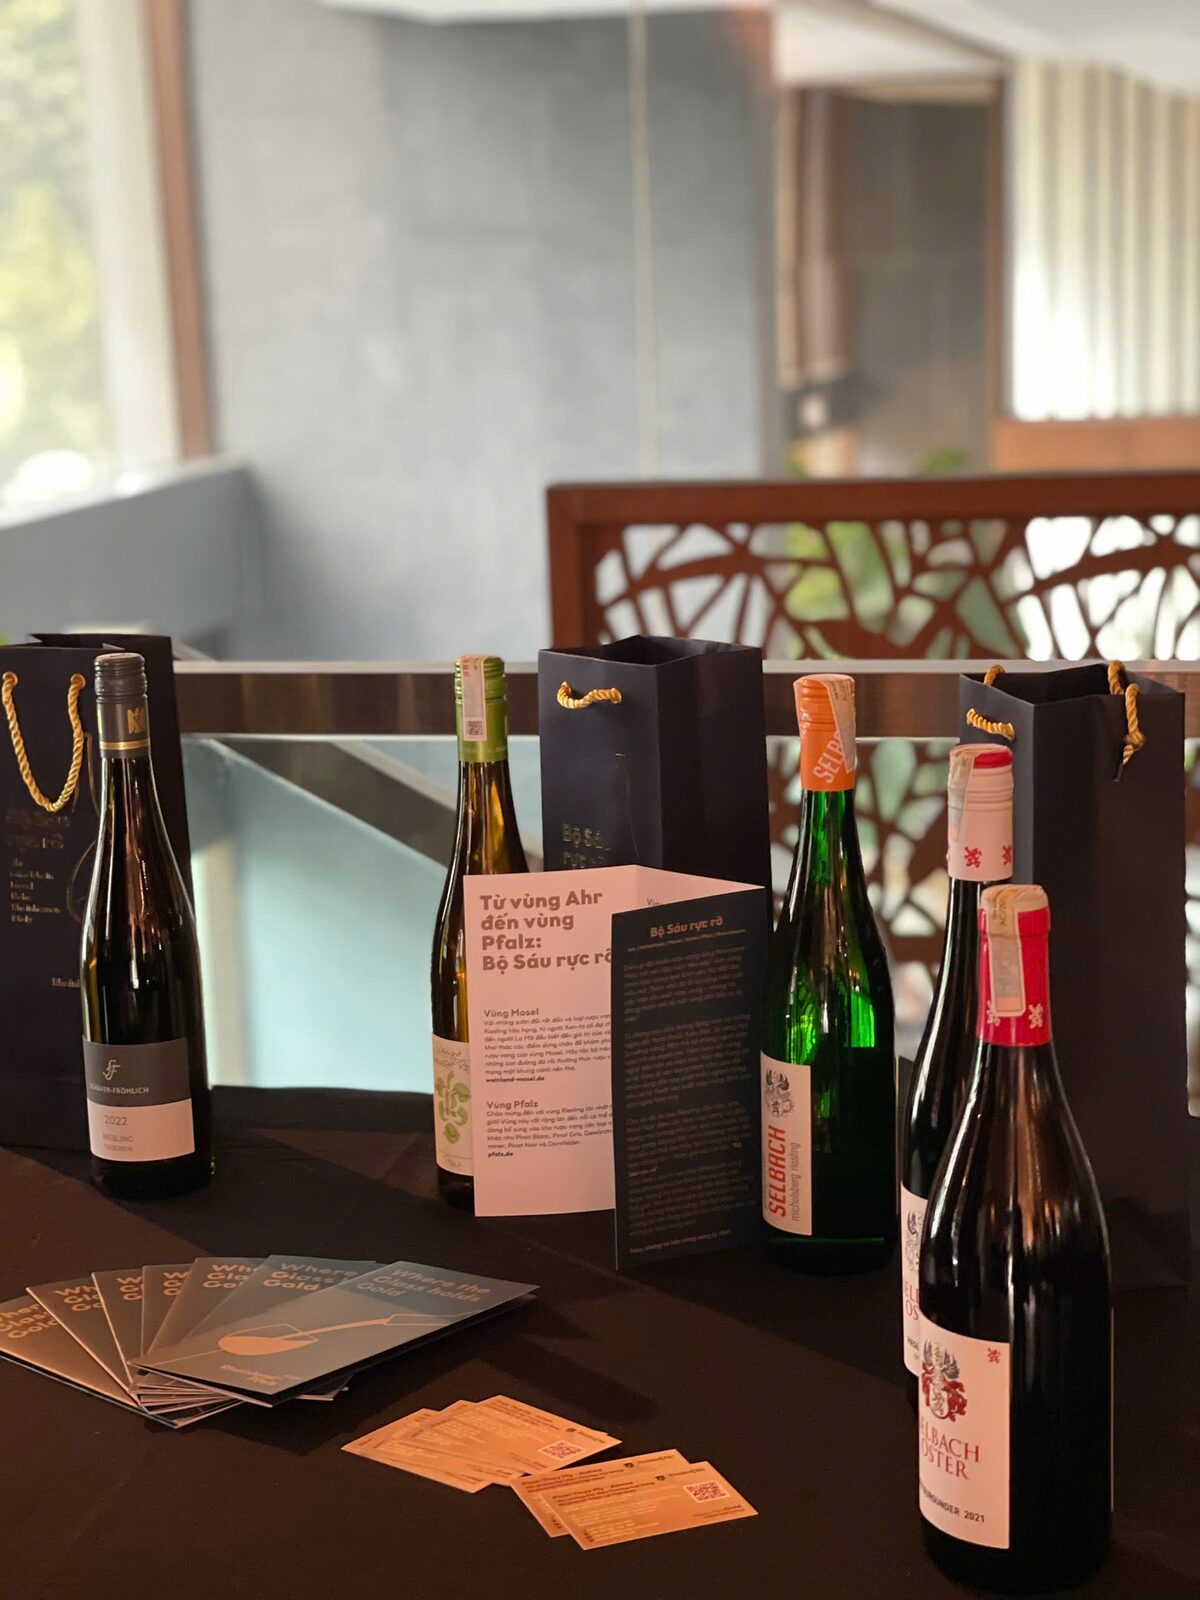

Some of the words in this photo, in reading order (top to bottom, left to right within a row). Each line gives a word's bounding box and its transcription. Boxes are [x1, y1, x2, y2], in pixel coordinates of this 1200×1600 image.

[480, 893, 507, 911] Từ
[509, 892, 560, 912] vùng
[565, 889, 603, 906] Ahr
[480, 912, 519, 930] đến
[524, 912, 575, 930] vùng
[482, 933, 542, 951] Pfalz:
[482, 954, 509, 975] Bộ
[513, 952, 552, 970] Sáu
[556, 953, 590, 972] rực
[511, 1008, 539, 1016] Mosel
[514, 1100, 539, 1109] Pfalz
[104, 1114, 128, 1126] 2022
[768, 1125, 786, 1217] SELBACH
[262, 1279, 320, 1292] Gold
[374, 1276, 427, 1292] Glass
[391, 1268, 456, 1288] Where
[356, 1282, 407, 1297] Gold
[920, 1416, 982, 1464] ELBACH
[964, 1510, 986, 1522] 2021
